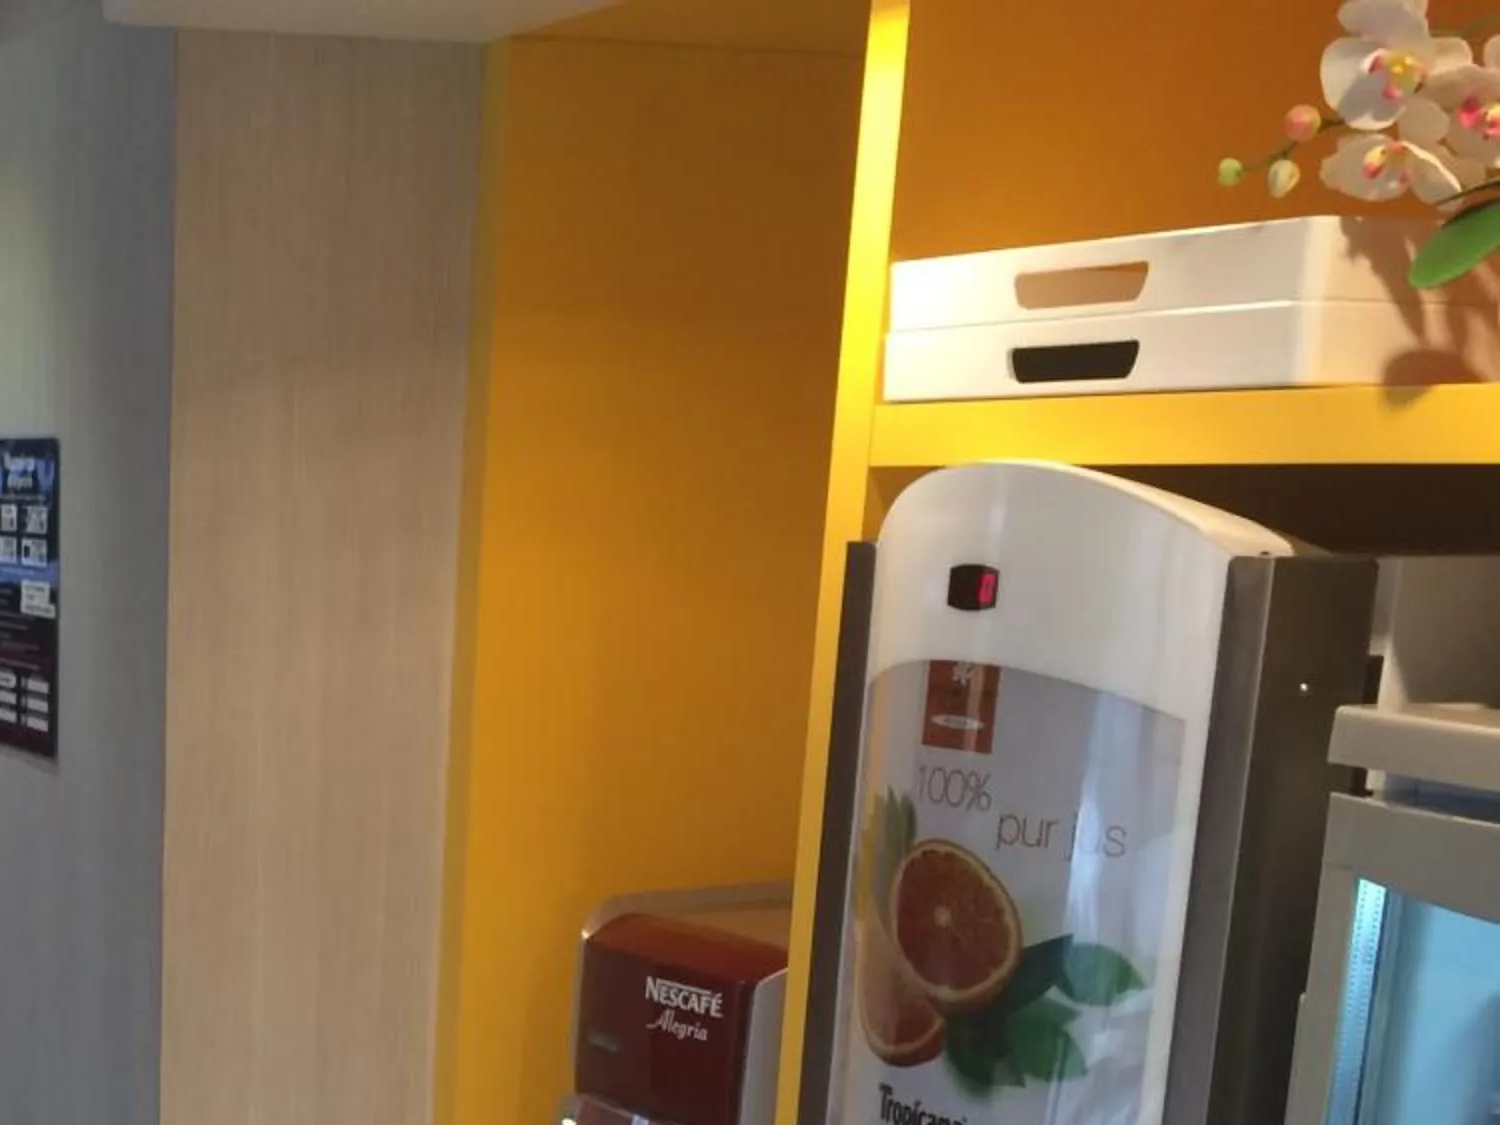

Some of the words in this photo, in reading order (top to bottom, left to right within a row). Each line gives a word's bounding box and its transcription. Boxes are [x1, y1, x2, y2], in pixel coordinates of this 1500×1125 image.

[917, 765, 992, 812] 100%
[995, 813, 1059, 851] pur
[645, 975, 723, 1018] NESCAFÉ
[645, 1007, 708, 1041] Alegria
